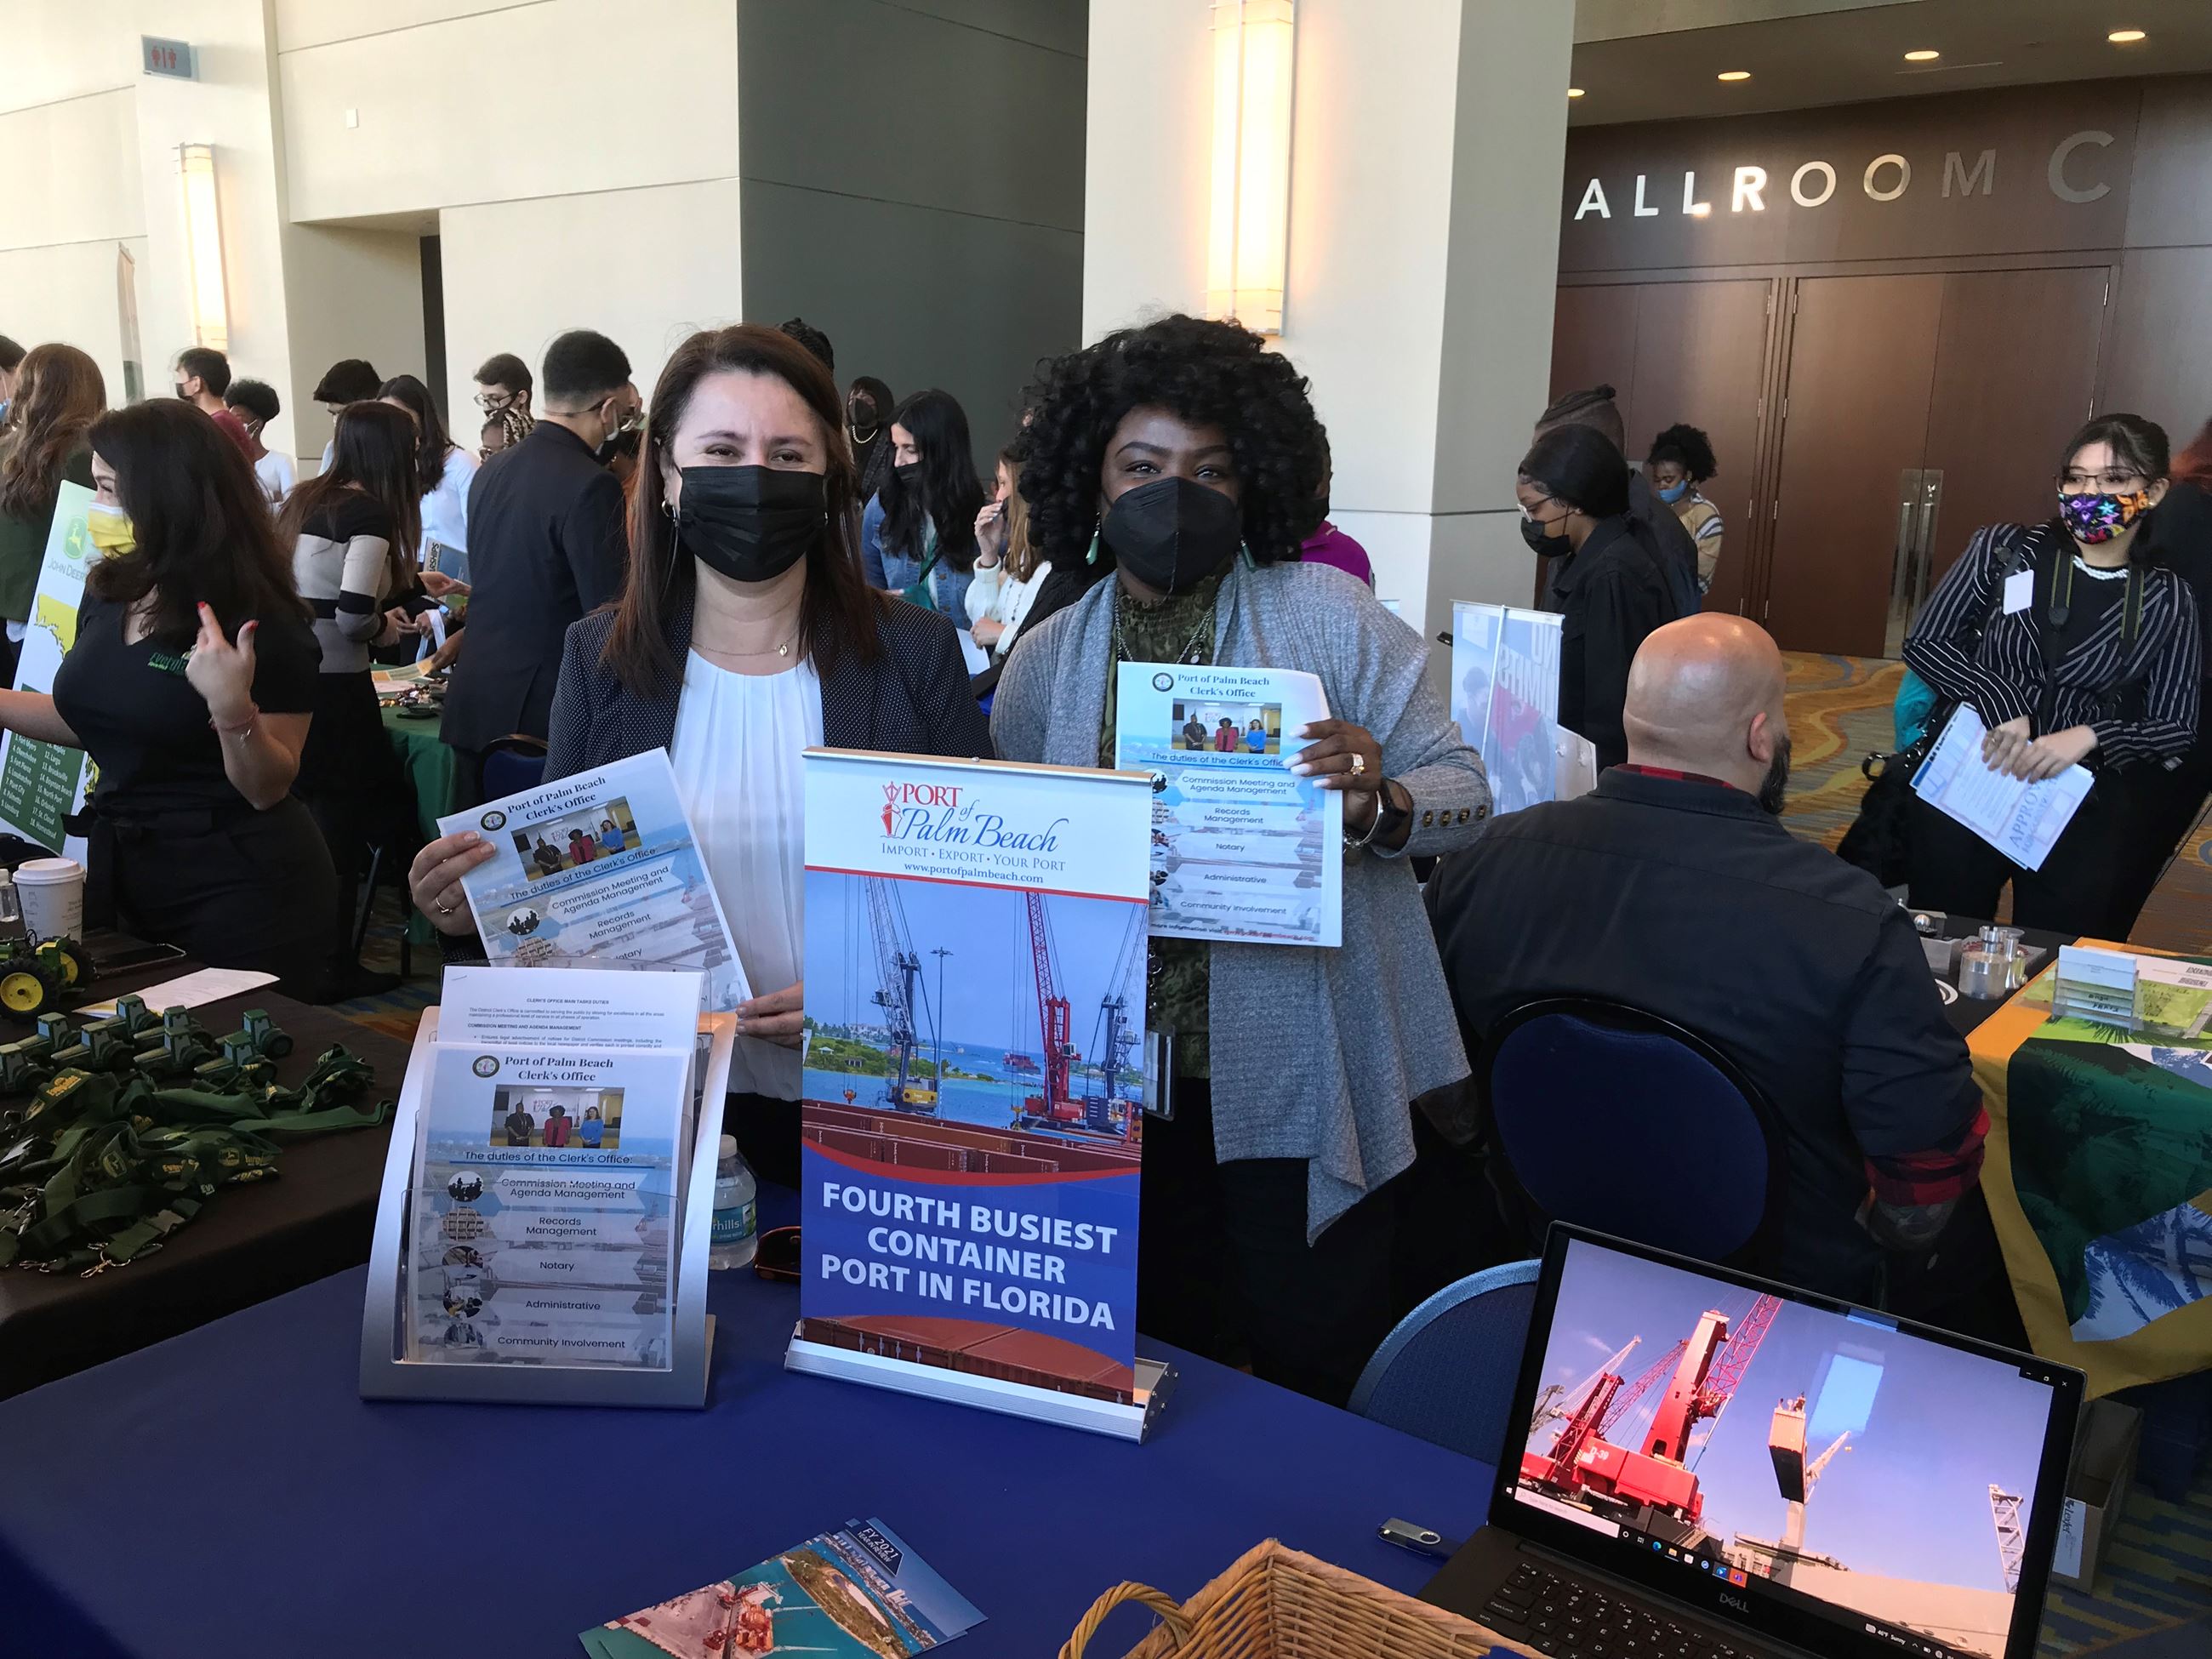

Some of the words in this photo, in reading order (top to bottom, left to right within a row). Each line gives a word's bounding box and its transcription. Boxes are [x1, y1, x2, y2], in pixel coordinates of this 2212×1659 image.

[2048, 129, 2116, 204] C
[48, 558, 66, 575] JOHN
[66, 564, 86, 583] DEER
[1177, 674, 1198, 682] Port
[1200, 675, 1211, 683] of
[1212, 676, 1237, 685] Palm
[1240, 676, 1269, 686] Beach
[1190, 687, 1223, 696] Clerk's
[1226, 687, 1256, 698] Office
[1170, 754, 1197, 762] duties
[1229, 757, 1259, 766] Clerk's
[1183, 776, 1237, 785] Commission
[1240, 778, 1274, 788] Meeting
[43, 788, 54, 799] North
[61, 785, 72, 797] Beach
[507, 801, 531, 813] Port
[533, 795, 544, 805] of
[545, 788, 573, 801] Palm
[575, 777, 606, 792] Beach
[902, 783, 963, 807] PORT
[1190, 784, 1224, 793] Agenda
[1227, 786, 1286, 795] Management
[41, 799, 56, 813] Orlando
[526, 803, 562, 820] Clerk's
[565, 795, 596, 808] Office
[959, 800, 980, 822] of
[43, 814, 55, 825] Cloud
[1205, 815, 1263, 824] Management
[899, 807, 970, 844] Palm
[972, 814, 1069, 852] Beach
[1216, 843, 1245, 852] Notary
[881, 842, 929, 858] IMPORT
[939, 849, 984, 864] EXPORT
[994, 854, 1029, 869] YOUR
[1033, 858, 1066, 872] PORT
[510, 890, 528, 900] The
[531, 879, 561, 893] duties
[563, 875, 573, 883] of
[575, 869, 590, 880] the
[594, 858, 625, 873] Clerk's
[627, 847, 658, 862] Office:
[904, 863, 1043, 883] www.portofpalmbeach.com
[1204, 874, 1267, 883] Administrative
[551, 884, 609, 909] Commission
[612, 871, 649, 891] Meeting
[650, 866, 669, 876] and
[563, 898, 600, 915] Agenda
[601, 877, 664, 902] Management
[1181, 901, 1232, 911] Community
[1234, 905, 1286, 914] Involvement
[597, 910, 635, 927] Records
[589, 914, 652, 939] Management
[505, 1057, 529, 1065] Port
[533, 1057, 546, 1066] of
[547, 1058, 575, 1067] Palm
[579, 1058, 613, 1068] Beach
[518, 1070, 558, 1080] Clerk's
[562, 1071, 596, 1081] Office
[465, 1152, 484, 1160] The
[487, 1152, 521, 1161] duties
[524, 1152, 536, 1161] of
[538, 1153, 556, 1162] the
[558, 1154, 594, 1163] Clerk's
[597, 1154, 633, 1164] Office:
[501, 1178, 567, 1189] Commission
[570, 1180, 611, 1191] Meeting
[614, 1181, 636, 1189] and
[510, 1188, 551, 1198] Agenda
[555, 1189, 624, 1200] Management
[539, 1217, 581, 1226] Records
[824, 1182, 960, 1229] FOURTH
[971, 1205, 1118, 1254] BUSIEST
[526, 1227, 597, 1237] Management
[868, 1227, 1065, 1284] CONTAINER
[539, 1262, 575, 1272] Notary
[822, 1254, 910, 1292] PORT
[919, 1271, 953, 1302] IN
[963, 1278, 1115, 1331] FLORIDA
[526, 1300, 601, 1310] Administrative
[497, 1337, 558, 1348] Community
[562, 1338, 625, 1348] Involvement
[1589, 1446, 1610, 1461] D-39
[858, 1531, 870, 1543] YEAR
[873, 1546, 892, 1562] REVIEW
[863, 1528, 879, 1538] FY
[875, 1539, 898, 1559] 2021
[1719, 1593, 1749, 1613] DELL
